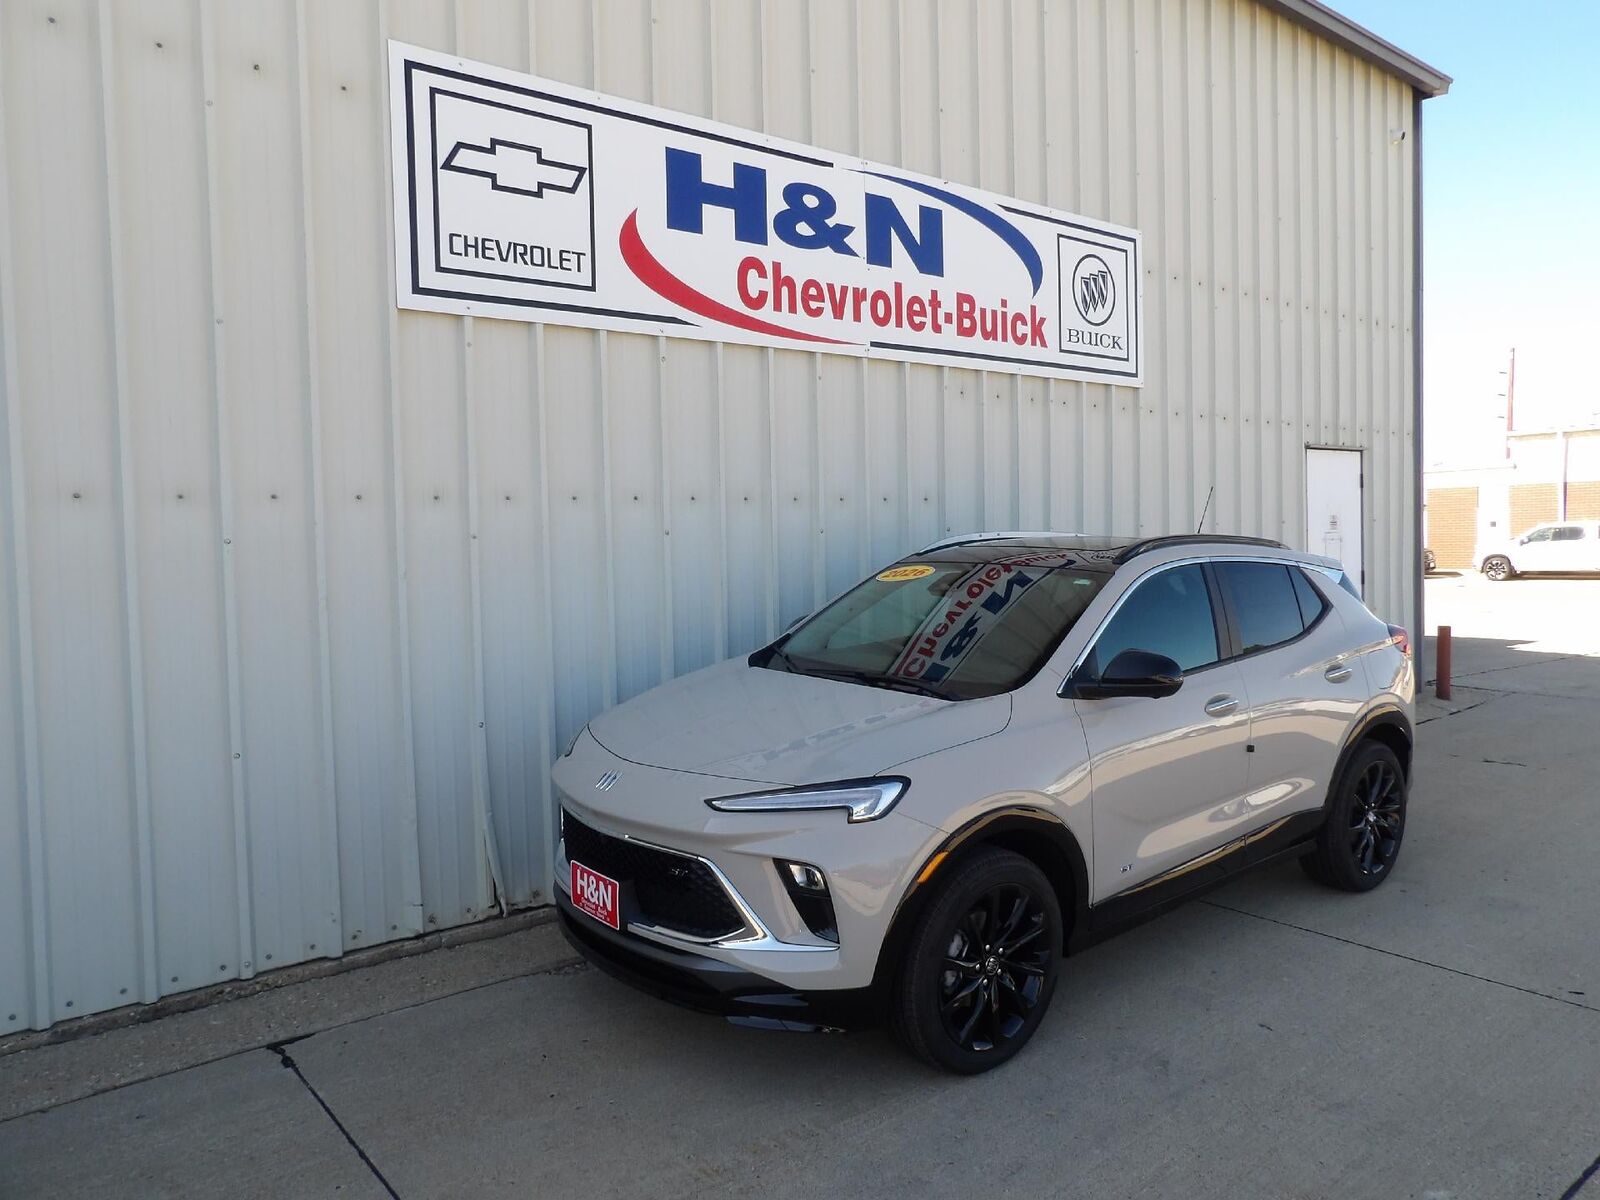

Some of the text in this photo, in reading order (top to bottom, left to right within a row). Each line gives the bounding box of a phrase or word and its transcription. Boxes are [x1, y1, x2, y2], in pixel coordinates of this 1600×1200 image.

[664, 145, 945, 278] H&N
[447, 232, 587, 274] CHEVROLET
[736, 255, 1049, 349] Chevrolet-Buick
[1067, 327, 1124, 351] BUICK
[576, 868, 612, 912] H&N
